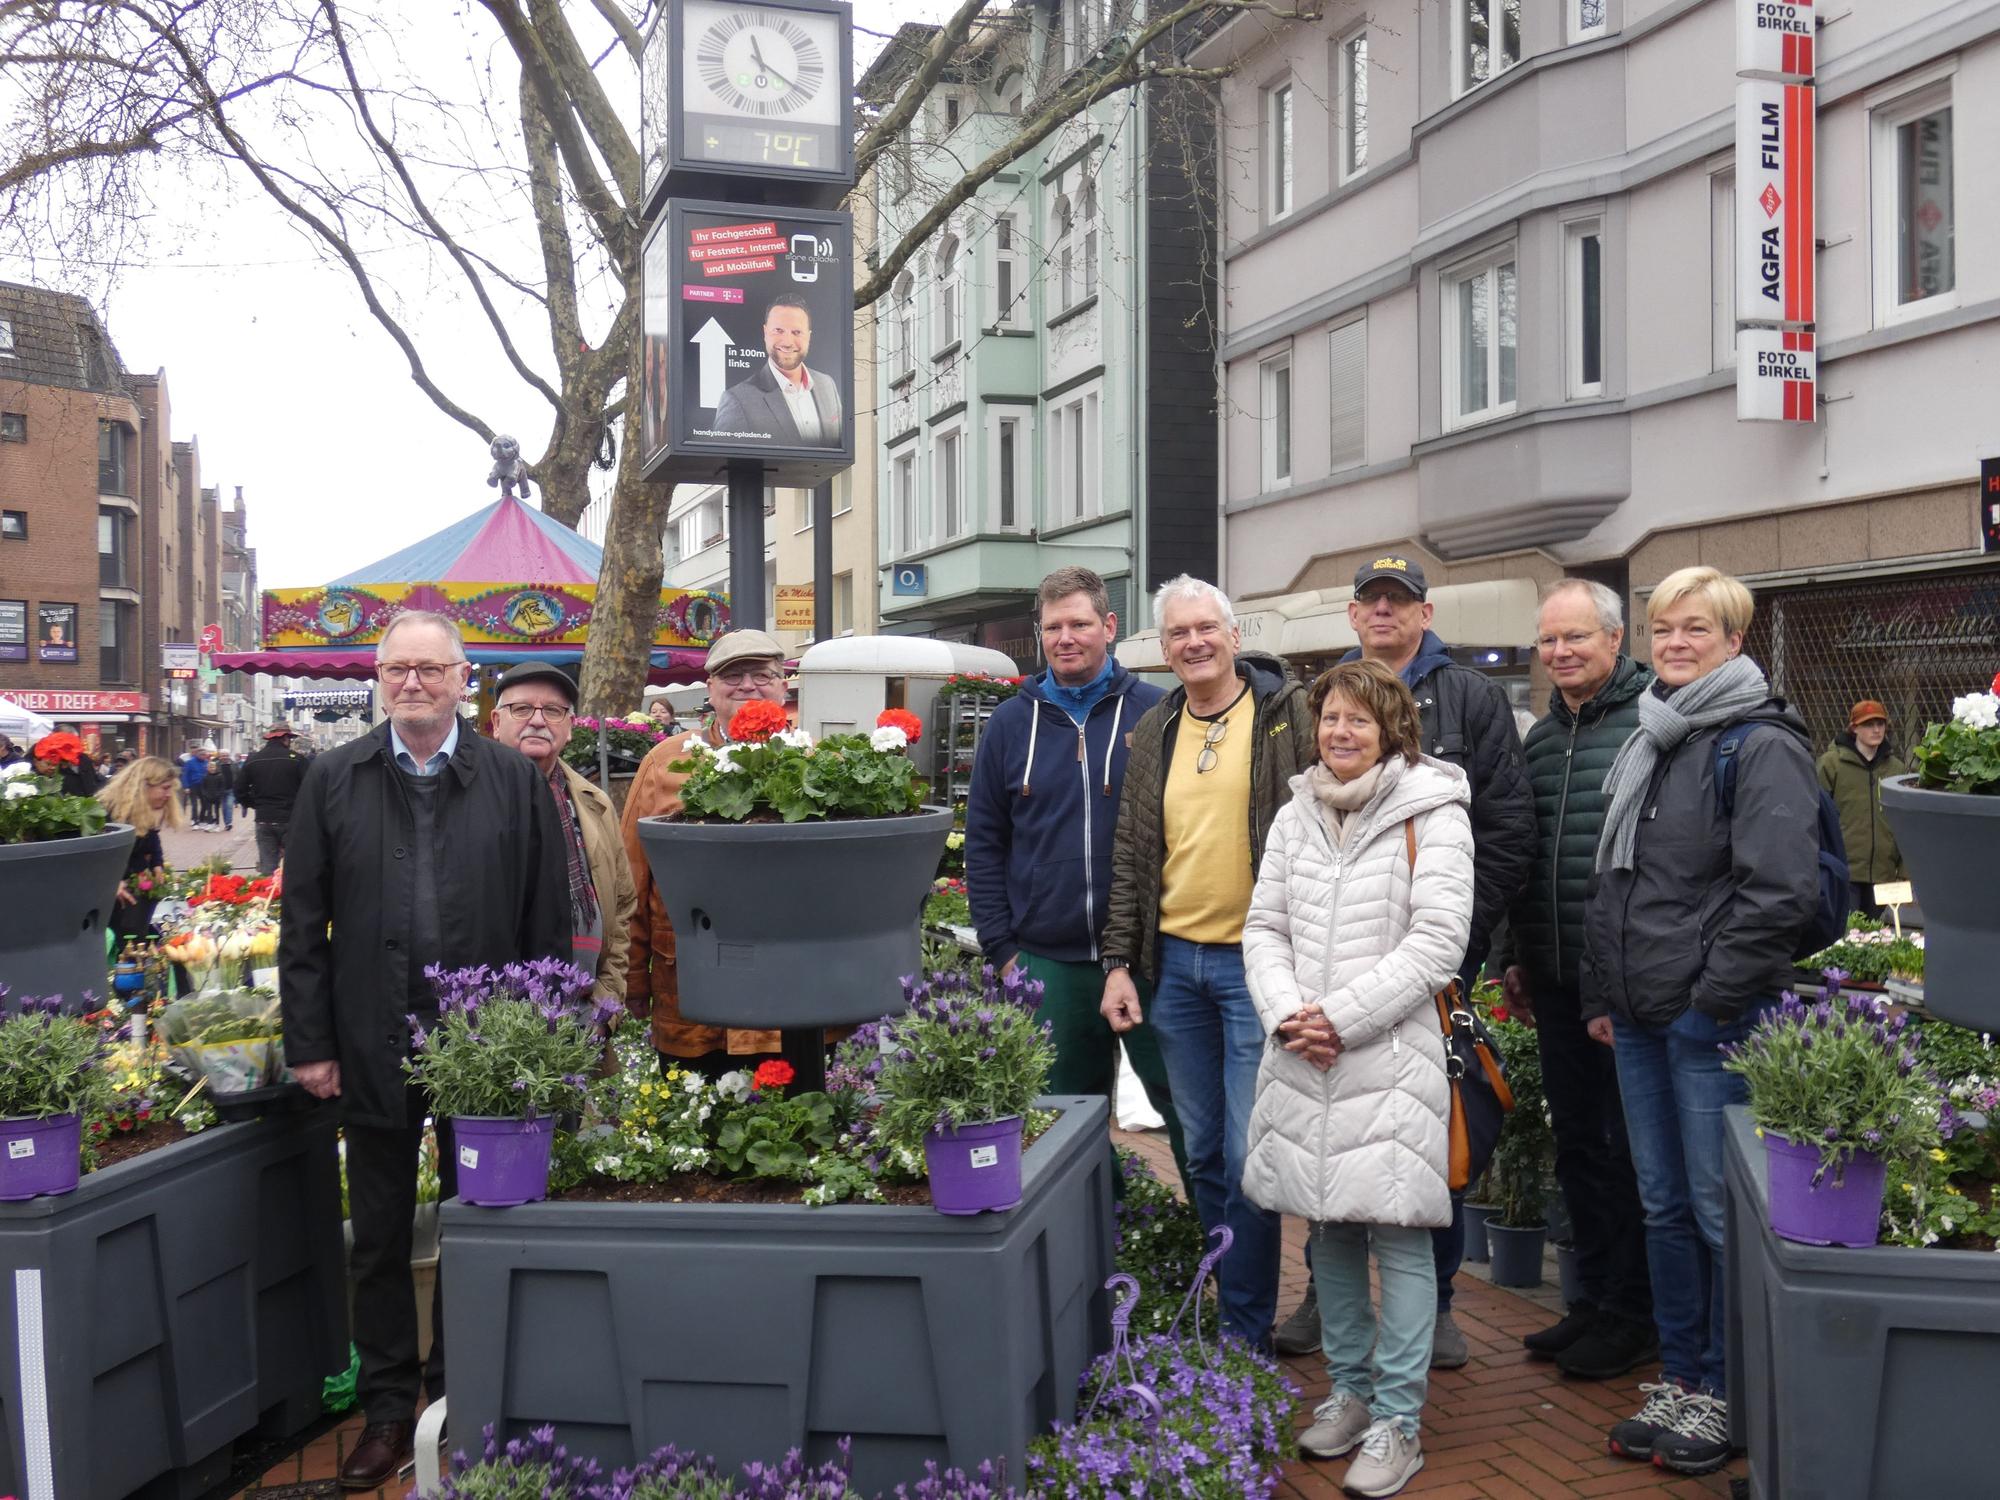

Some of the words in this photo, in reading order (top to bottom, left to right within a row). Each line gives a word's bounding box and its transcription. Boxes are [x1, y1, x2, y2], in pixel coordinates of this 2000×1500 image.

[1757, 3, 1796, 18] FOTO
[1757, 16, 1810, 34] BIRKEL
[1761, 102, 1780, 171] FILM
[696, 232, 709, 241] Ihr
[712, 226, 773, 241] Fachgeschäft
[691, 248, 704, 258] für
[707, 245, 748, 257] Festnetz,
[750, 241, 786, 253] Internet
[706, 263, 724, 274] und
[727, 260, 773, 272] Mobilfunk
[1761, 226, 1780, 302] AGFA
[689, 289, 715, 297] PARTNER
[728, 347, 737, 356] in
[740, 349, 766, 358] 100m
[1758, 351, 1797, 365] FOTO
[728, 359, 750, 369] links
[1758, 365, 1811, 380] BIRKEL
[693, 428, 772, 439] handystore-opladen.de
[1238, 617, 1263, 638] AUS
[52, 693, 97, 710] TREFF
[295, 694, 368, 706] BACKFISCH
